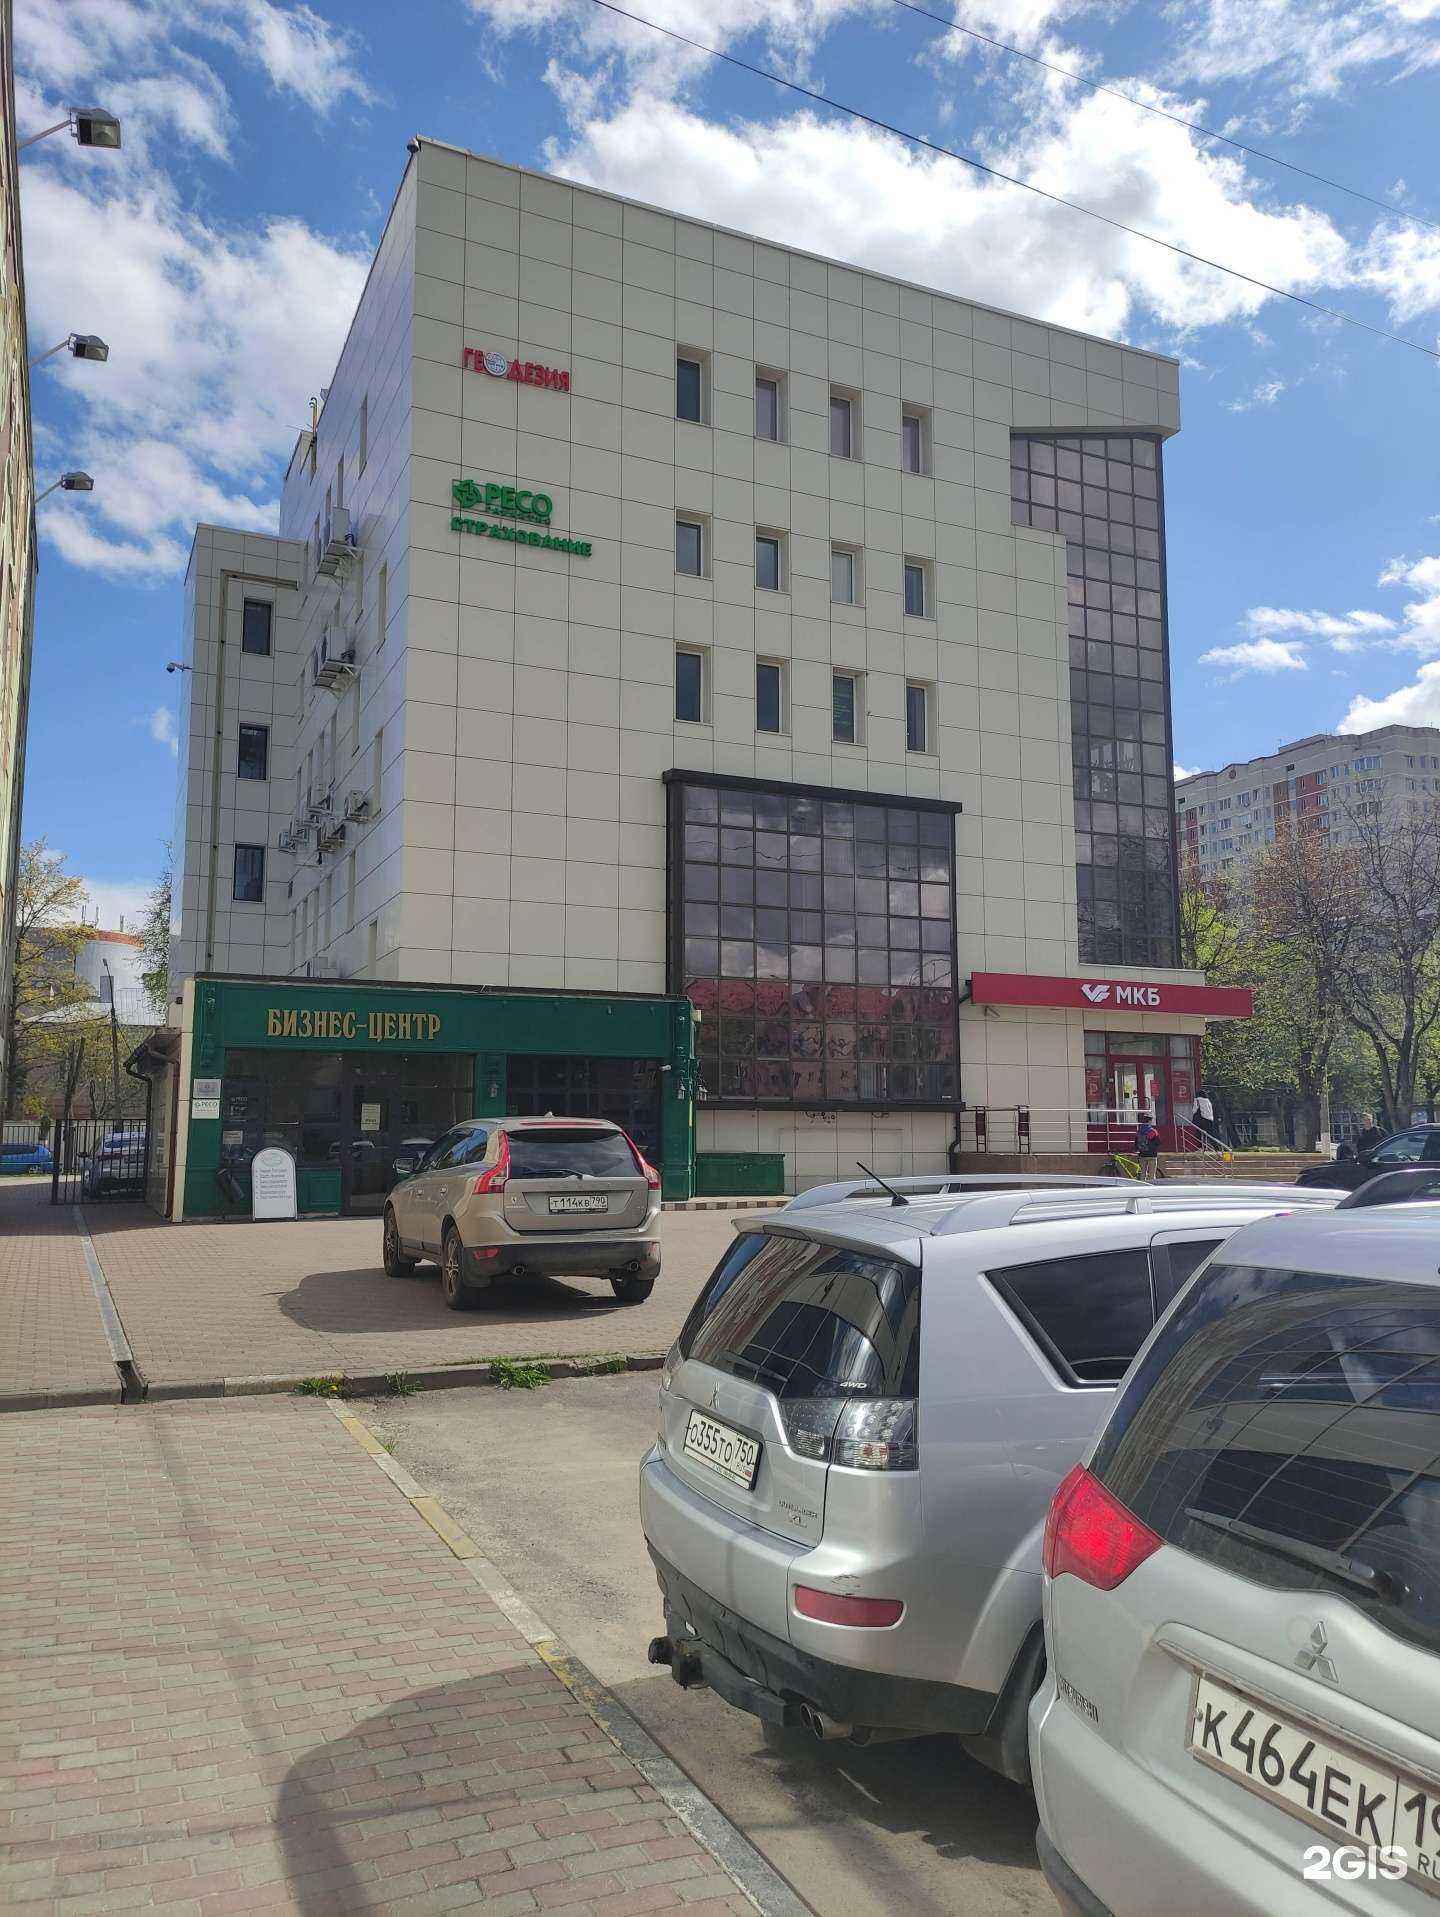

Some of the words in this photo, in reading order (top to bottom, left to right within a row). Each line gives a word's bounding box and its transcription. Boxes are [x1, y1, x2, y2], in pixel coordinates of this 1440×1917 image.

[485, 483, 553, 517] РЕСО
[451, 516, 593, 557] СТРАХОВАНИЕ
[1116, 985, 1161, 1006] МКБ
[267, 1008, 442, 1042] БИЗНЕС-ЦЕНТР
[840, 1381, 867, 1389] 4WD
[1202, 1702, 1388, 1849] К464ЕК
